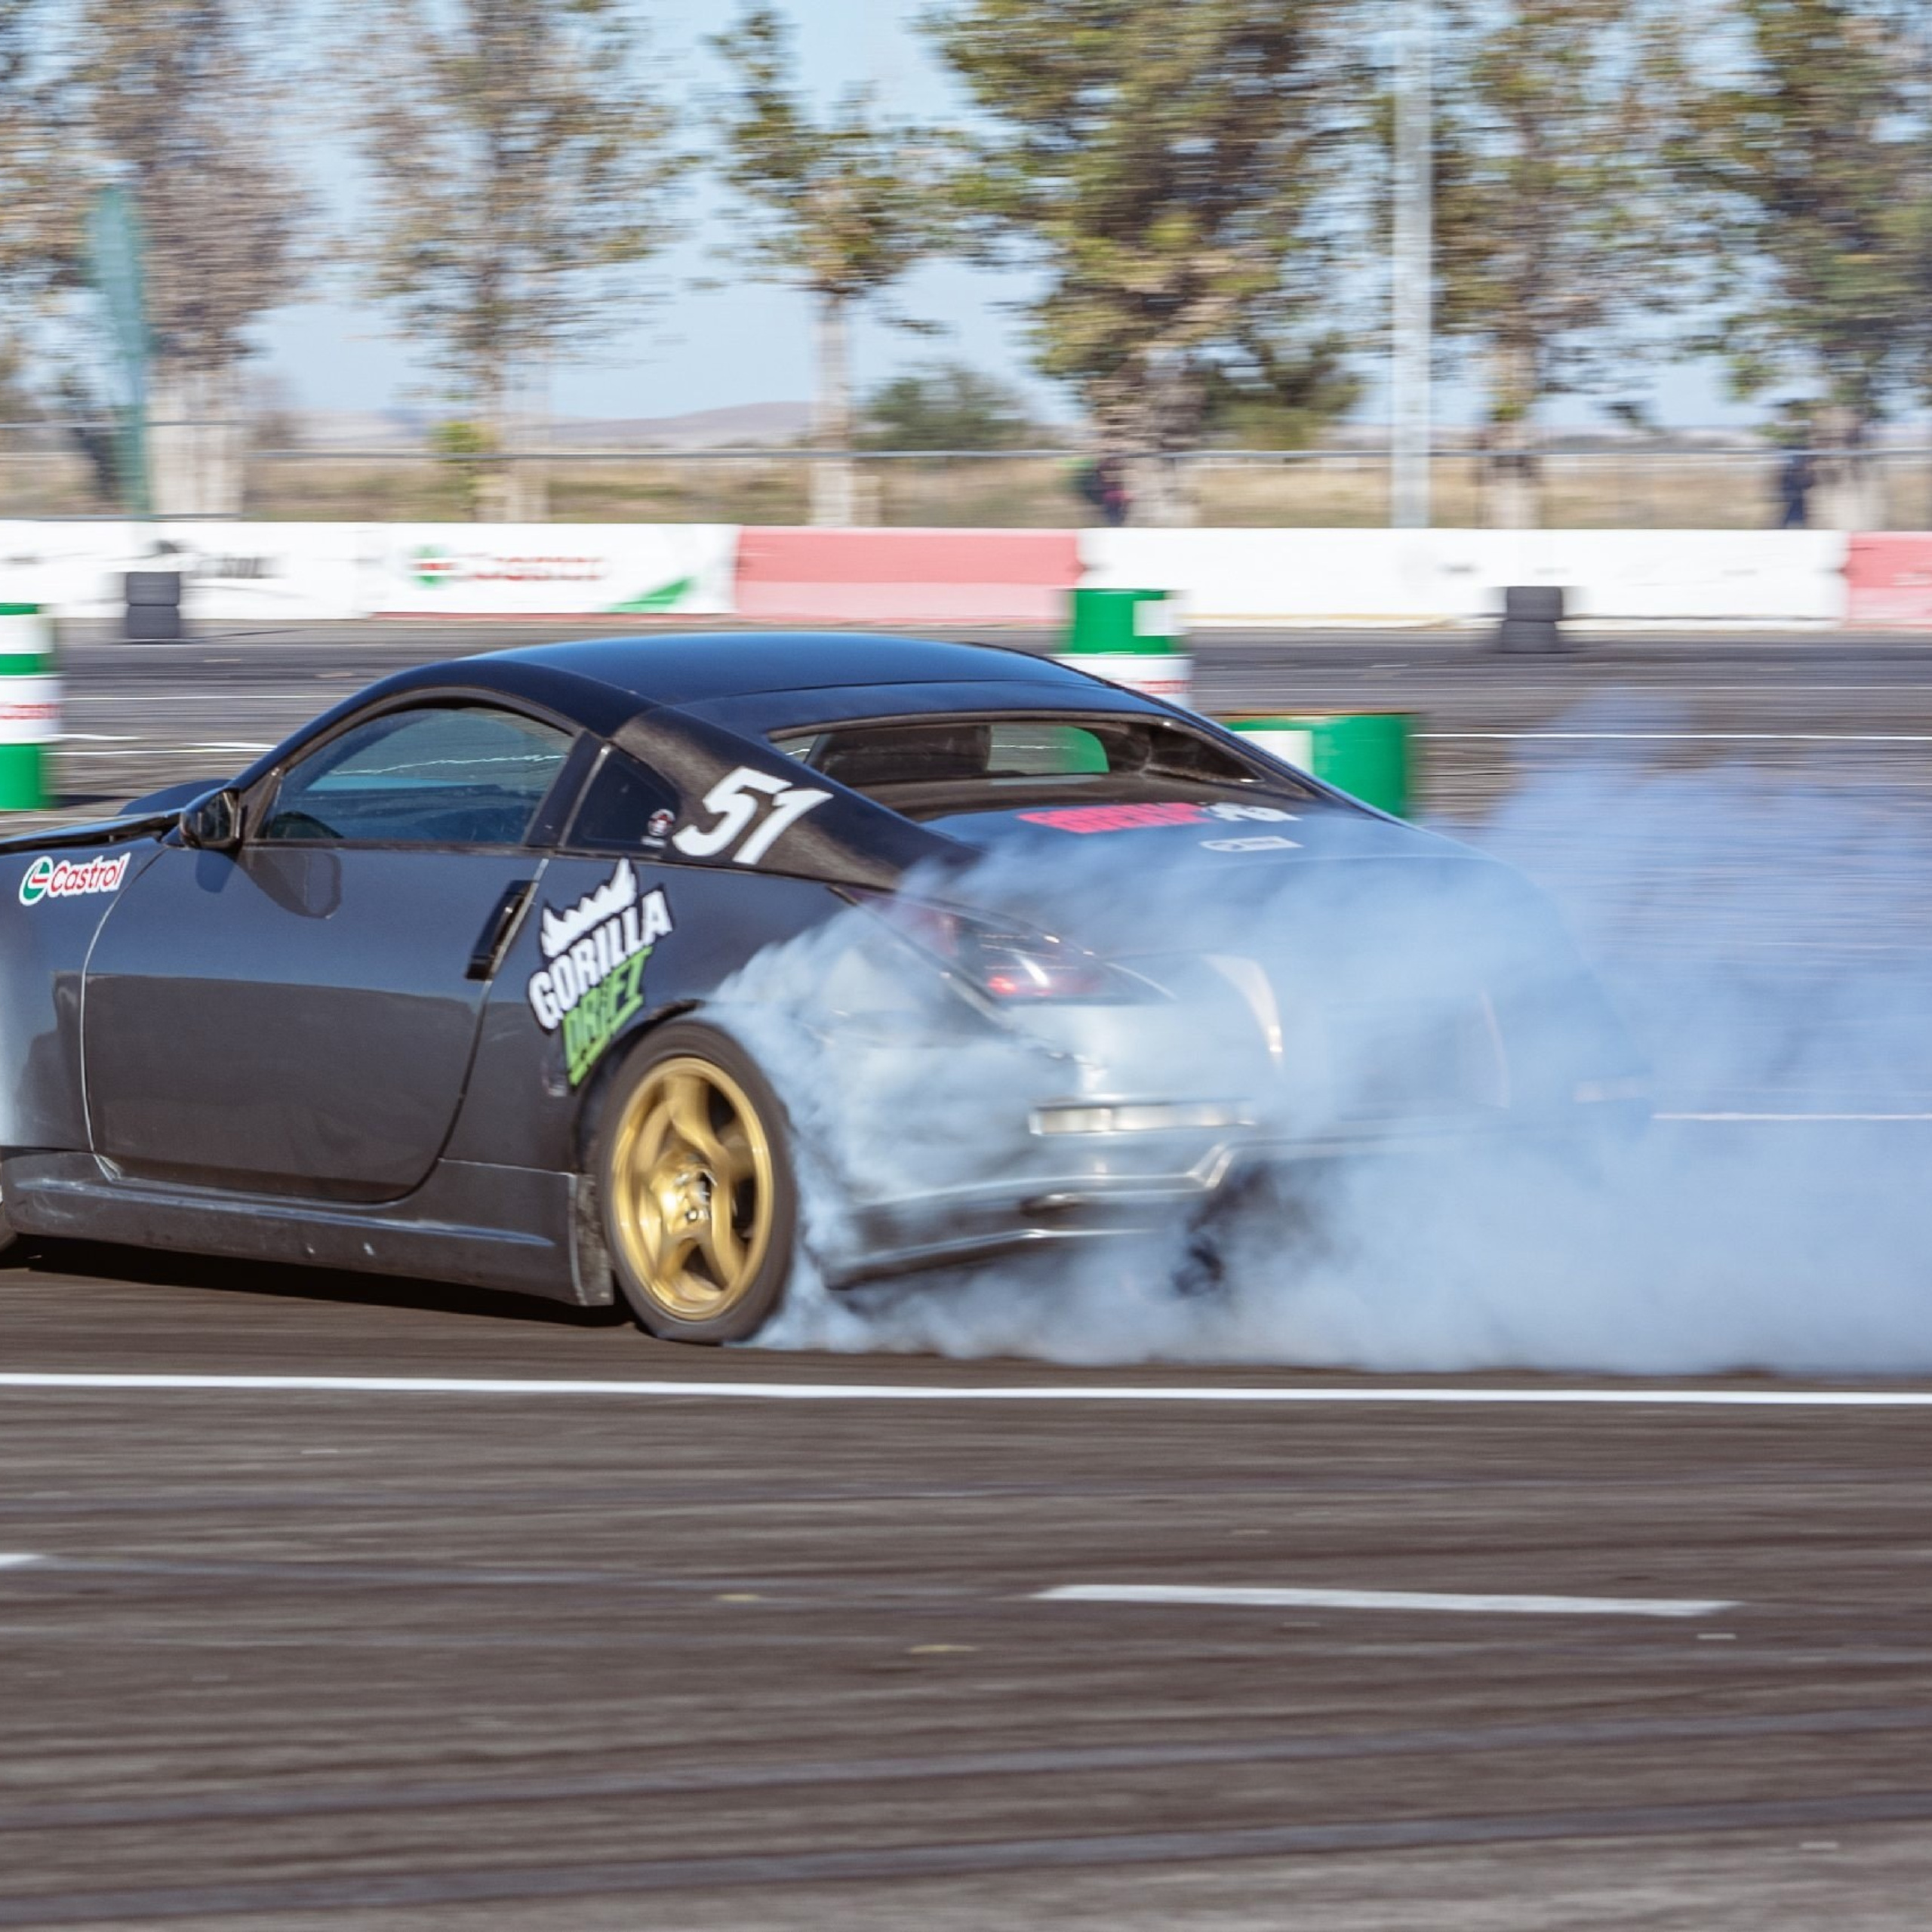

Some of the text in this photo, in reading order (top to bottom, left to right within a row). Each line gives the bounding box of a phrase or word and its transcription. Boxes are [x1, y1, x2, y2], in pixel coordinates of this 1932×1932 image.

[672, 766, 833, 864] 51
[50, 858, 127, 894] Castrol
[529, 891, 672, 1029] GORILLA
[562, 946, 653, 1073] DRIFT
